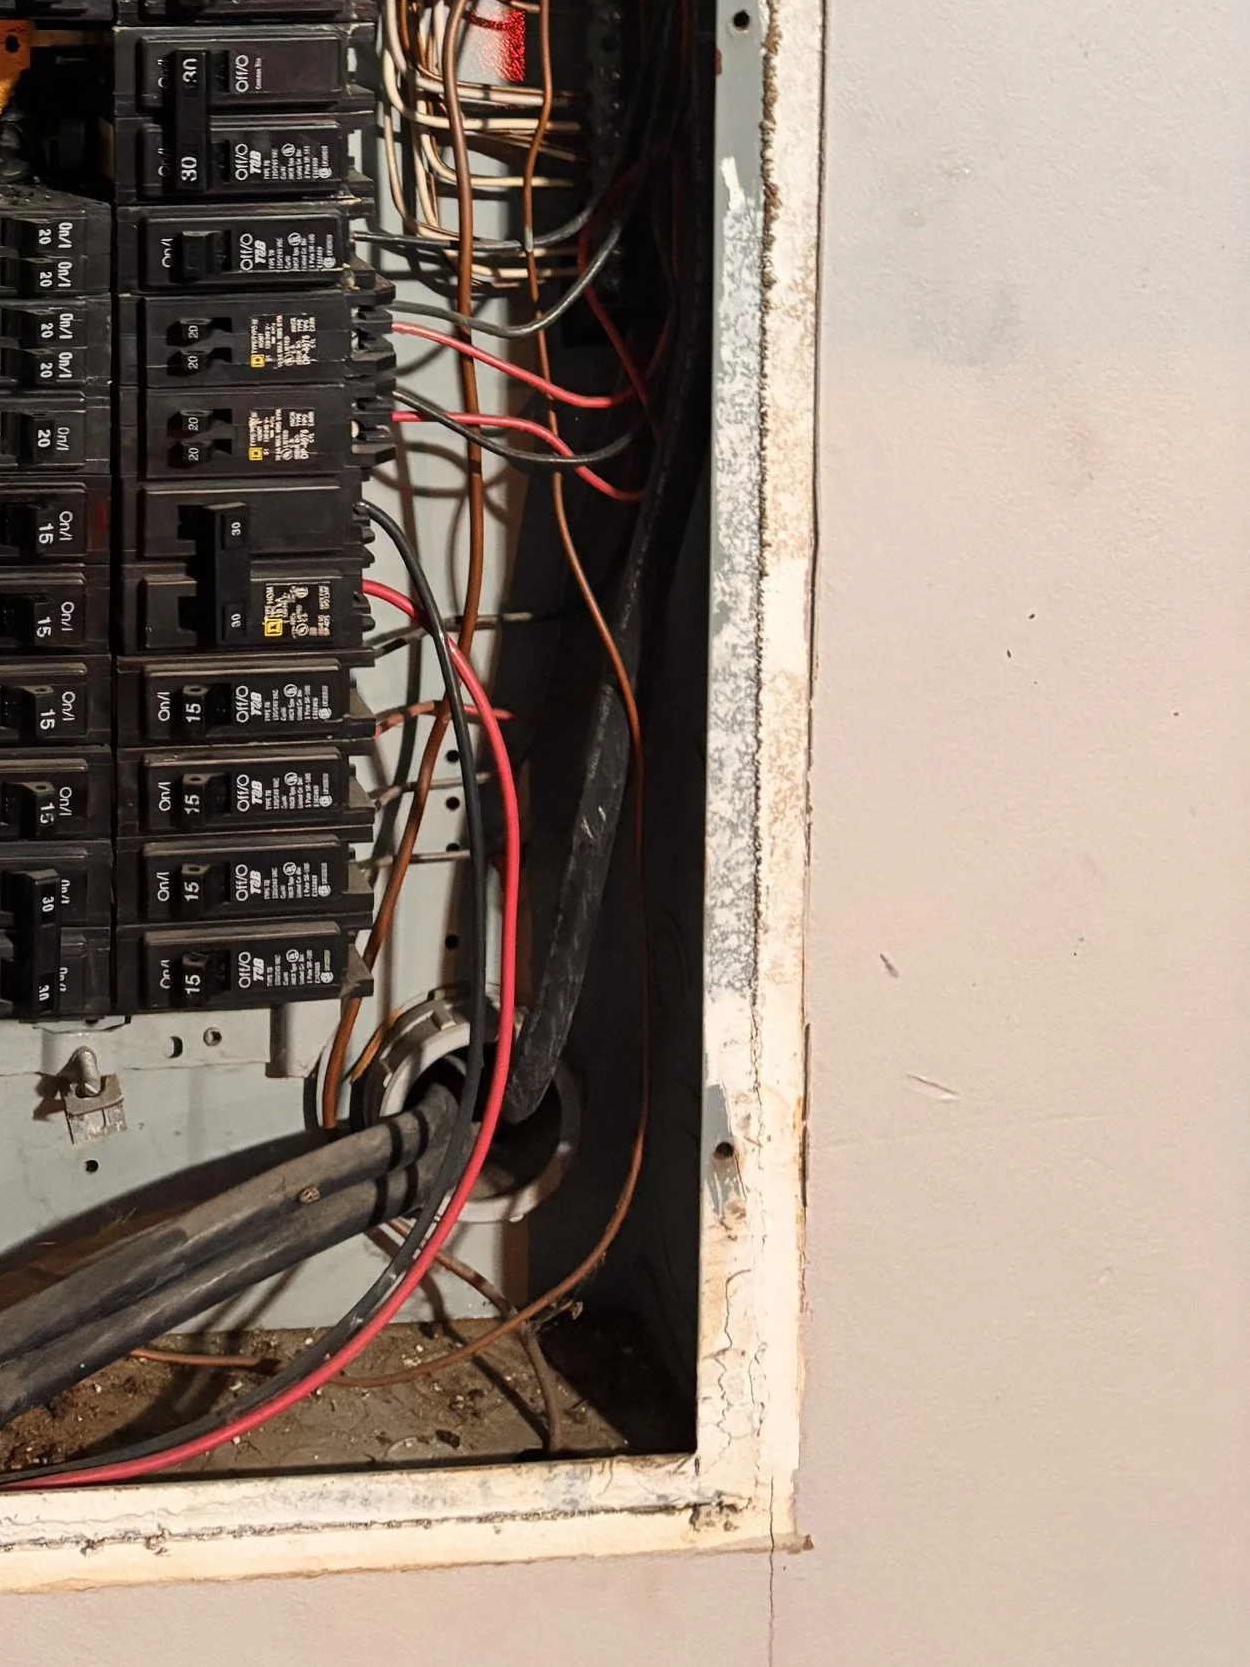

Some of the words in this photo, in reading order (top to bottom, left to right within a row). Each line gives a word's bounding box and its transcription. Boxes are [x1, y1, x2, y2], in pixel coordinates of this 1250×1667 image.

[182, 58, 198, 83] 30
[235, 54, 249, 93] Off/O
[181, 156, 198, 182] 30
[234, 143, 249, 181] Off/O
[38, 229, 52, 245] 20
[57, 222, 73, 249] On/I
[239, 233, 253, 271] Off/O
[39, 271, 53, 287] 20
[57, 261, 73, 288] On/I
[40, 322, 54, 339] 20
[58, 313, 74, 340] On/I
[187, 325, 199, 338] 20
[40, 362, 54, 378] 20
[58, 352, 74, 378] On/I
[187, 356, 199, 369] 20
[188, 417, 199, 431] 20
[37, 429, 52, 448] 20
[56, 427, 70, 451] On/I
[188, 447, 199, 461] 20
[38, 523, 54, 544] 15
[59, 511, 73, 541] On/I
[231, 521, 242, 536] 30
[36, 616, 52, 638] 15
[60, 601, 75, 631] On/I
[61, 691, 76, 721] On/I
[157, 692, 170, 722] On/I
[185, 703, 201, 723] 15
[235, 685, 249, 723] Off/O
[39, 709, 55, 730] 15
[58, 786, 72, 816] On/I
[158, 781, 171, 812] On/I
[184, 794, 200, 815] 15
[236, 774, 250, 812] Off/O
[39, 802, 55, 824] 15
[156, 872, 170, 902] On/I
[184, 881, 200, 902] 15
[235, 864, 249, 902] Off/O
[41, 896, 55, 913] 30
[159, 960, 171, 990] On/I
[238, 951, 251, 989] Off/O
[185, 974, 201, 995] 15
